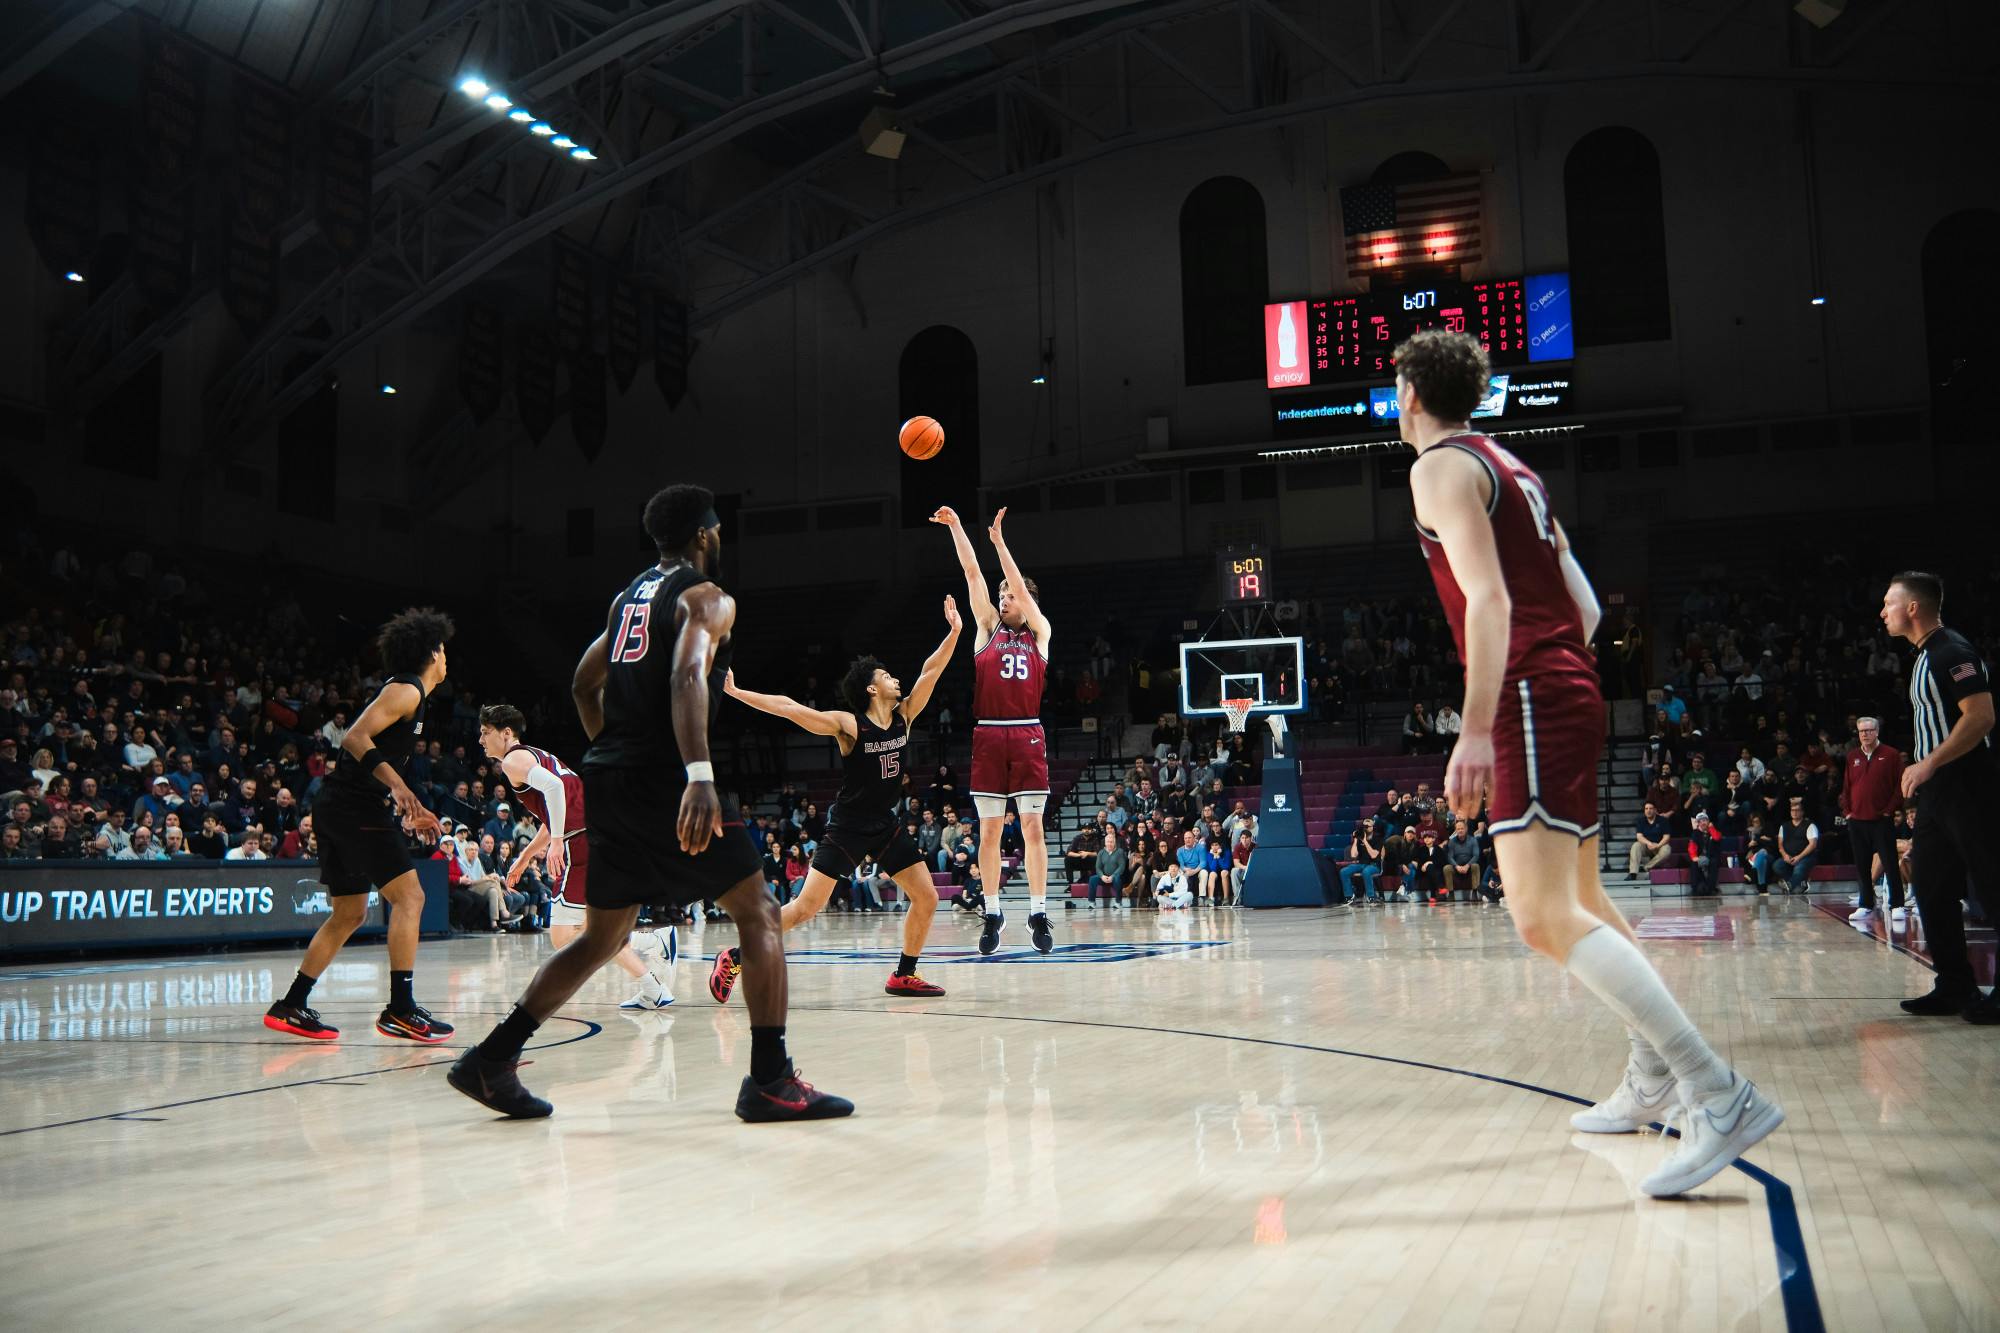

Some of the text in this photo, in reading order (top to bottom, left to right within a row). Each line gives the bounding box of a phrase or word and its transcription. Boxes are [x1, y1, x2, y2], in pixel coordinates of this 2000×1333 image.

[1403, 291, 1436, 310] 6:07
[1478, 289, 1521, 302] 10 0 2
[1538, 290, 1555, 306] peco
[1319, 311, 1327, 319] 4
[1481, 305, 1489, 315] 8
[1515, 303, 1521, 311] 4
[1318, 319, 1358, 332] 12 0 0
[1445, 316, 1465, 333] 20
[1482, 318, 1489, 327] 4
[1315, 335, 1327, 345] 23
[1353, 332, 1359, 340] 4
[1376, 324, 1389, 341] 15
[1480, 328, 1523, 340] 15 0 4
[1540, 324, 1557, 341] peco
[1317, 344, 1359, 357] 35 0 3
[1500, 341, 1508, 351] 0
[1516, 340, 1523, 349] 2
[1317, 359, 1328, 369] 30
[1353, 356, 1360, 366] 2
[1375, 357, 1383, 370] 5
[1273, 372, 1303, 385] enjoy
[1508, 385, 1520, 393] We
[1277, 404, 1353, 421] Independence
[1233, 558, 1263, 574] 6:07
[1240, 574, 1260, 598] 19
[611, 603, 651, 663] 13
[1000, 653, 1029, 680] 35
[864, 735, 907, 753] HARVARD
[879, 751, 900, 780] 15
[1, 886, 274, 924] UP TRAVEL EXPERTS
